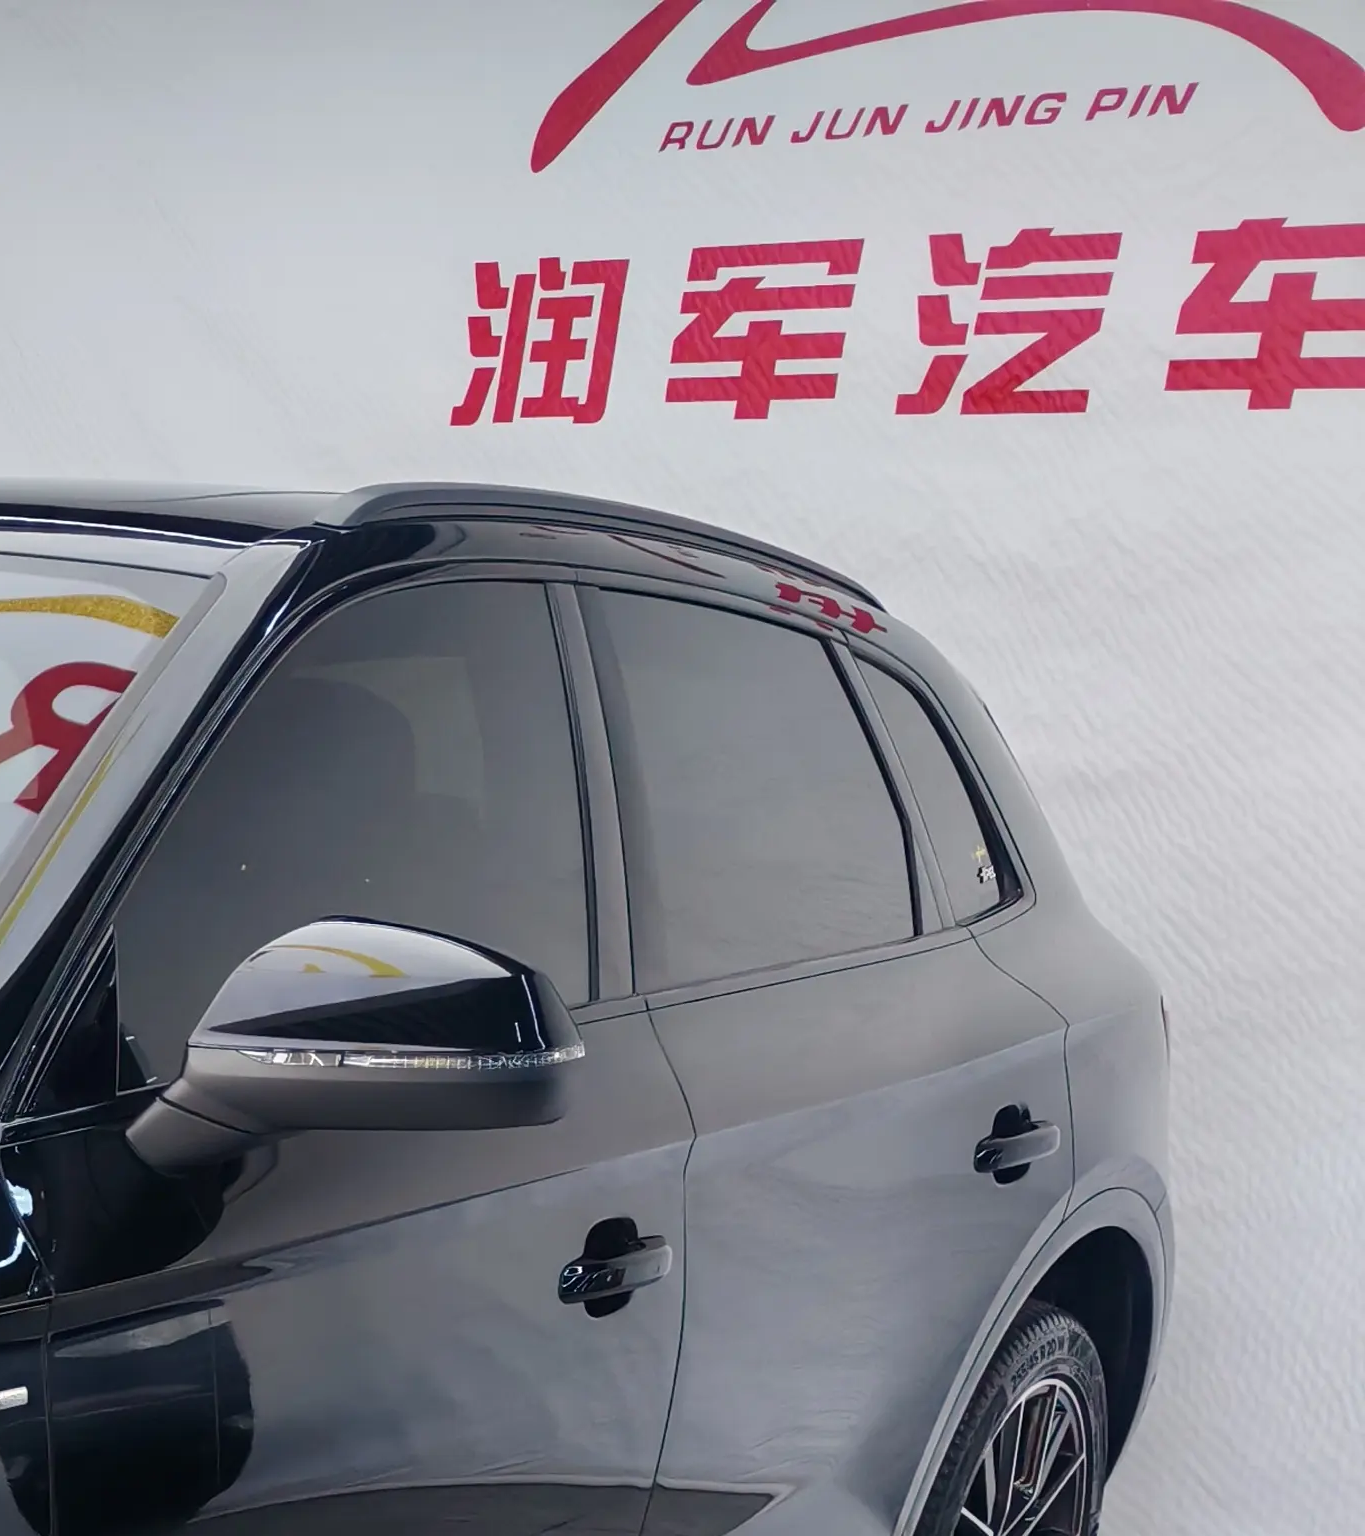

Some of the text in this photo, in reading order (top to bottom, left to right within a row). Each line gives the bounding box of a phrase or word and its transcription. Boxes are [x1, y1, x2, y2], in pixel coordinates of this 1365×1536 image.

[659, 82, 1199, 152] RUN JUN JING PIN
[449, 217, 1365, 427] 润军汽车
